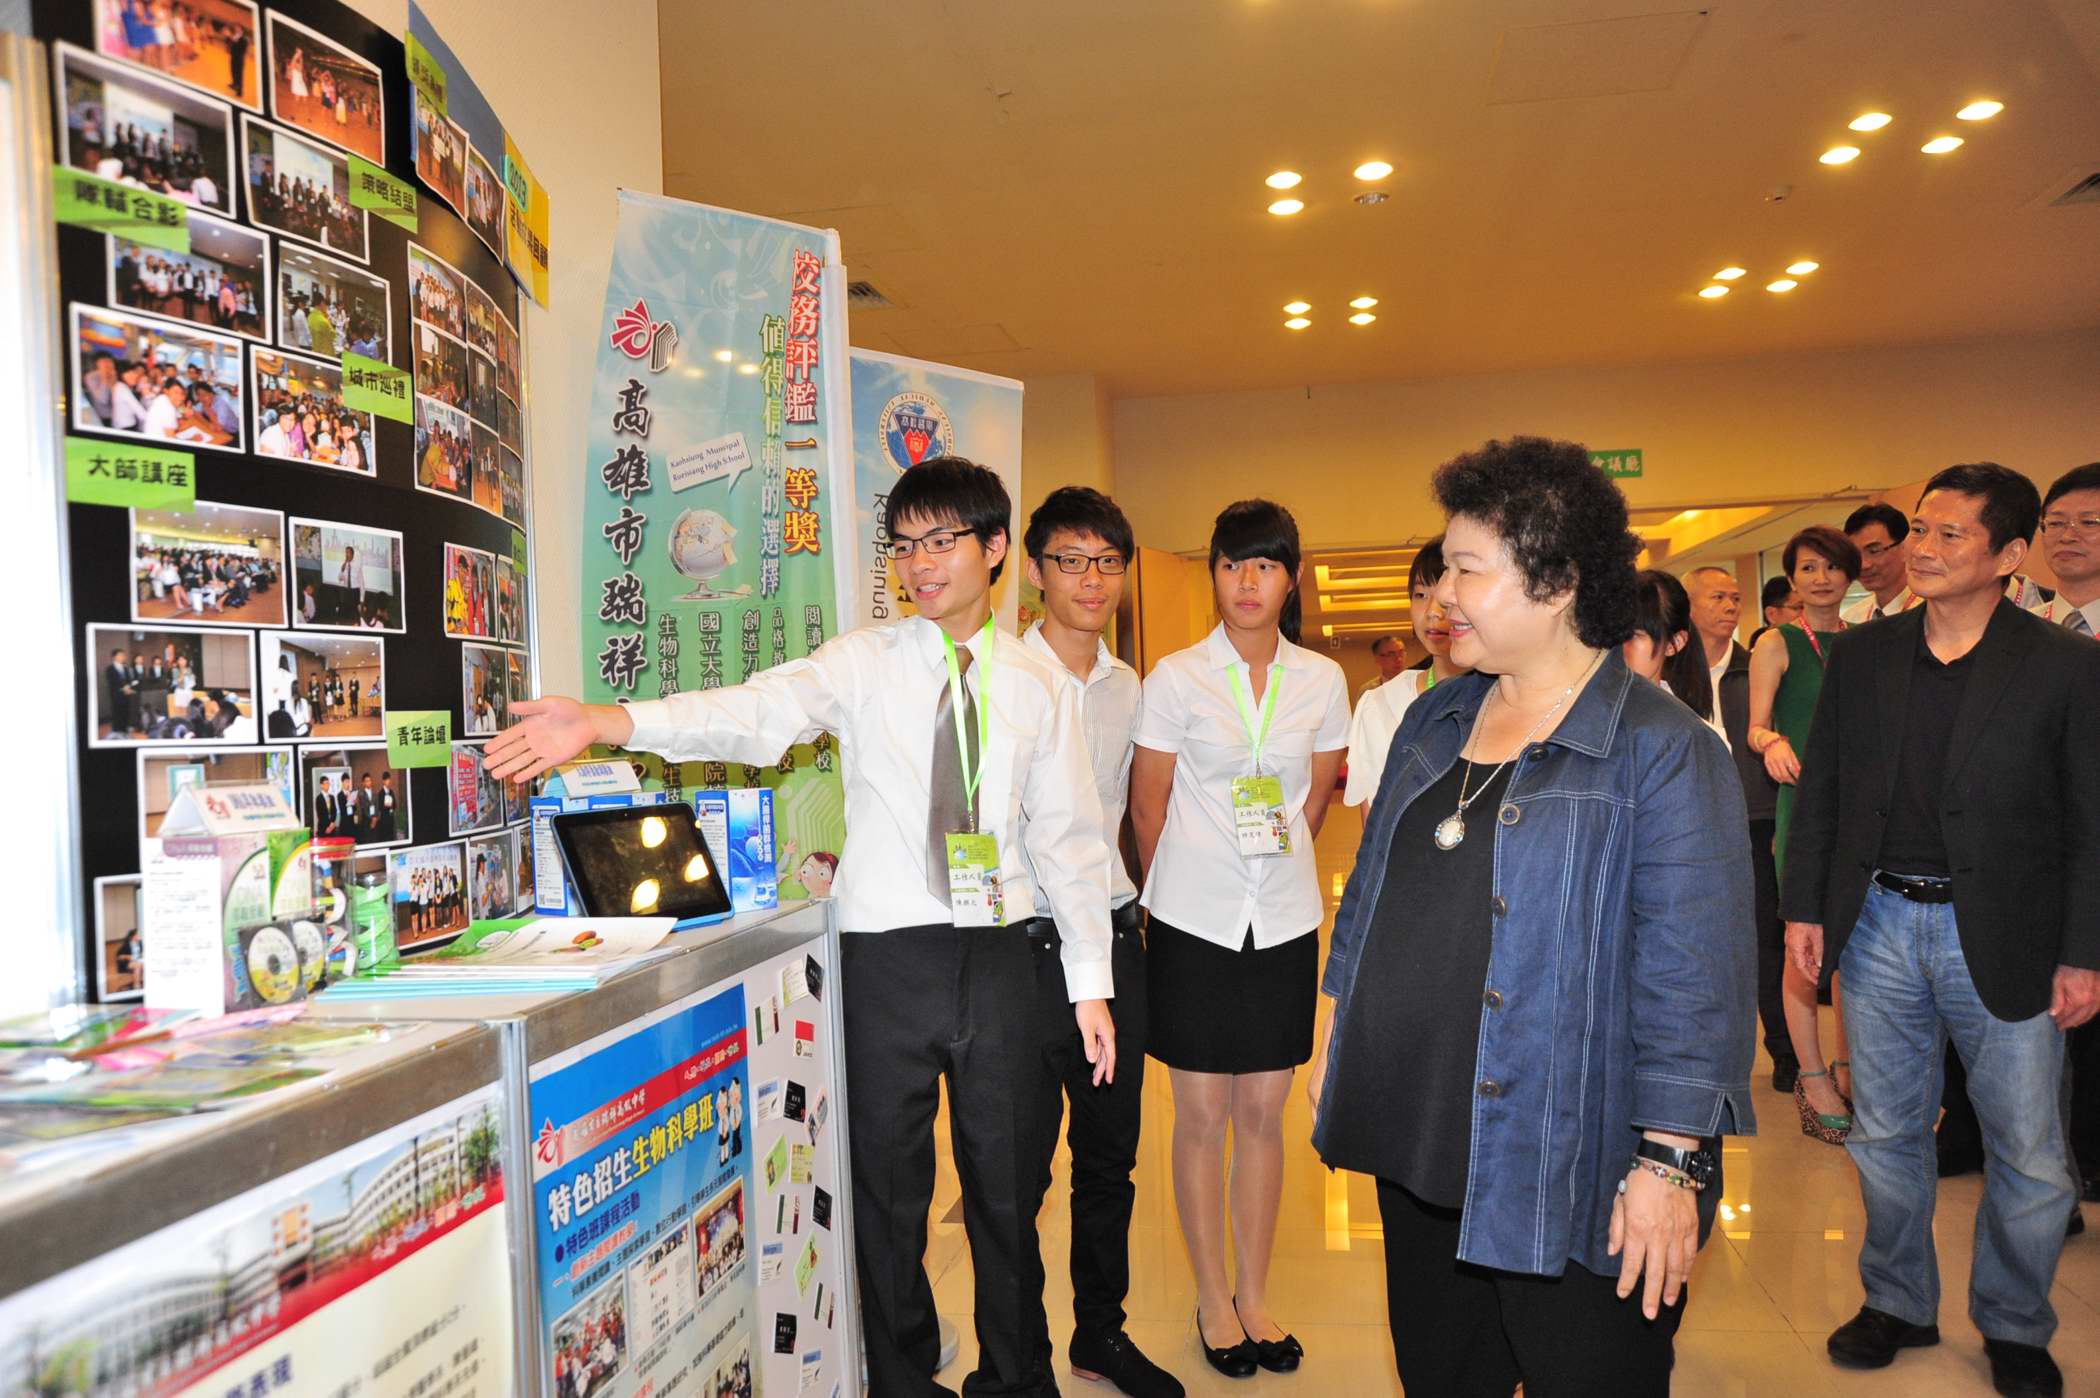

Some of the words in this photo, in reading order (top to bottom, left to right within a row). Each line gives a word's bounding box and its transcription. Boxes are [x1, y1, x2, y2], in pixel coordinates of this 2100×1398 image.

[349, 366, 405, 399] 城市巡禮
[88, 454, 188, 487] 大師講座
[397, 725, 446, 746] 青年論壇
[548, 1091, 715, 1232] 特色招生生物科學班
